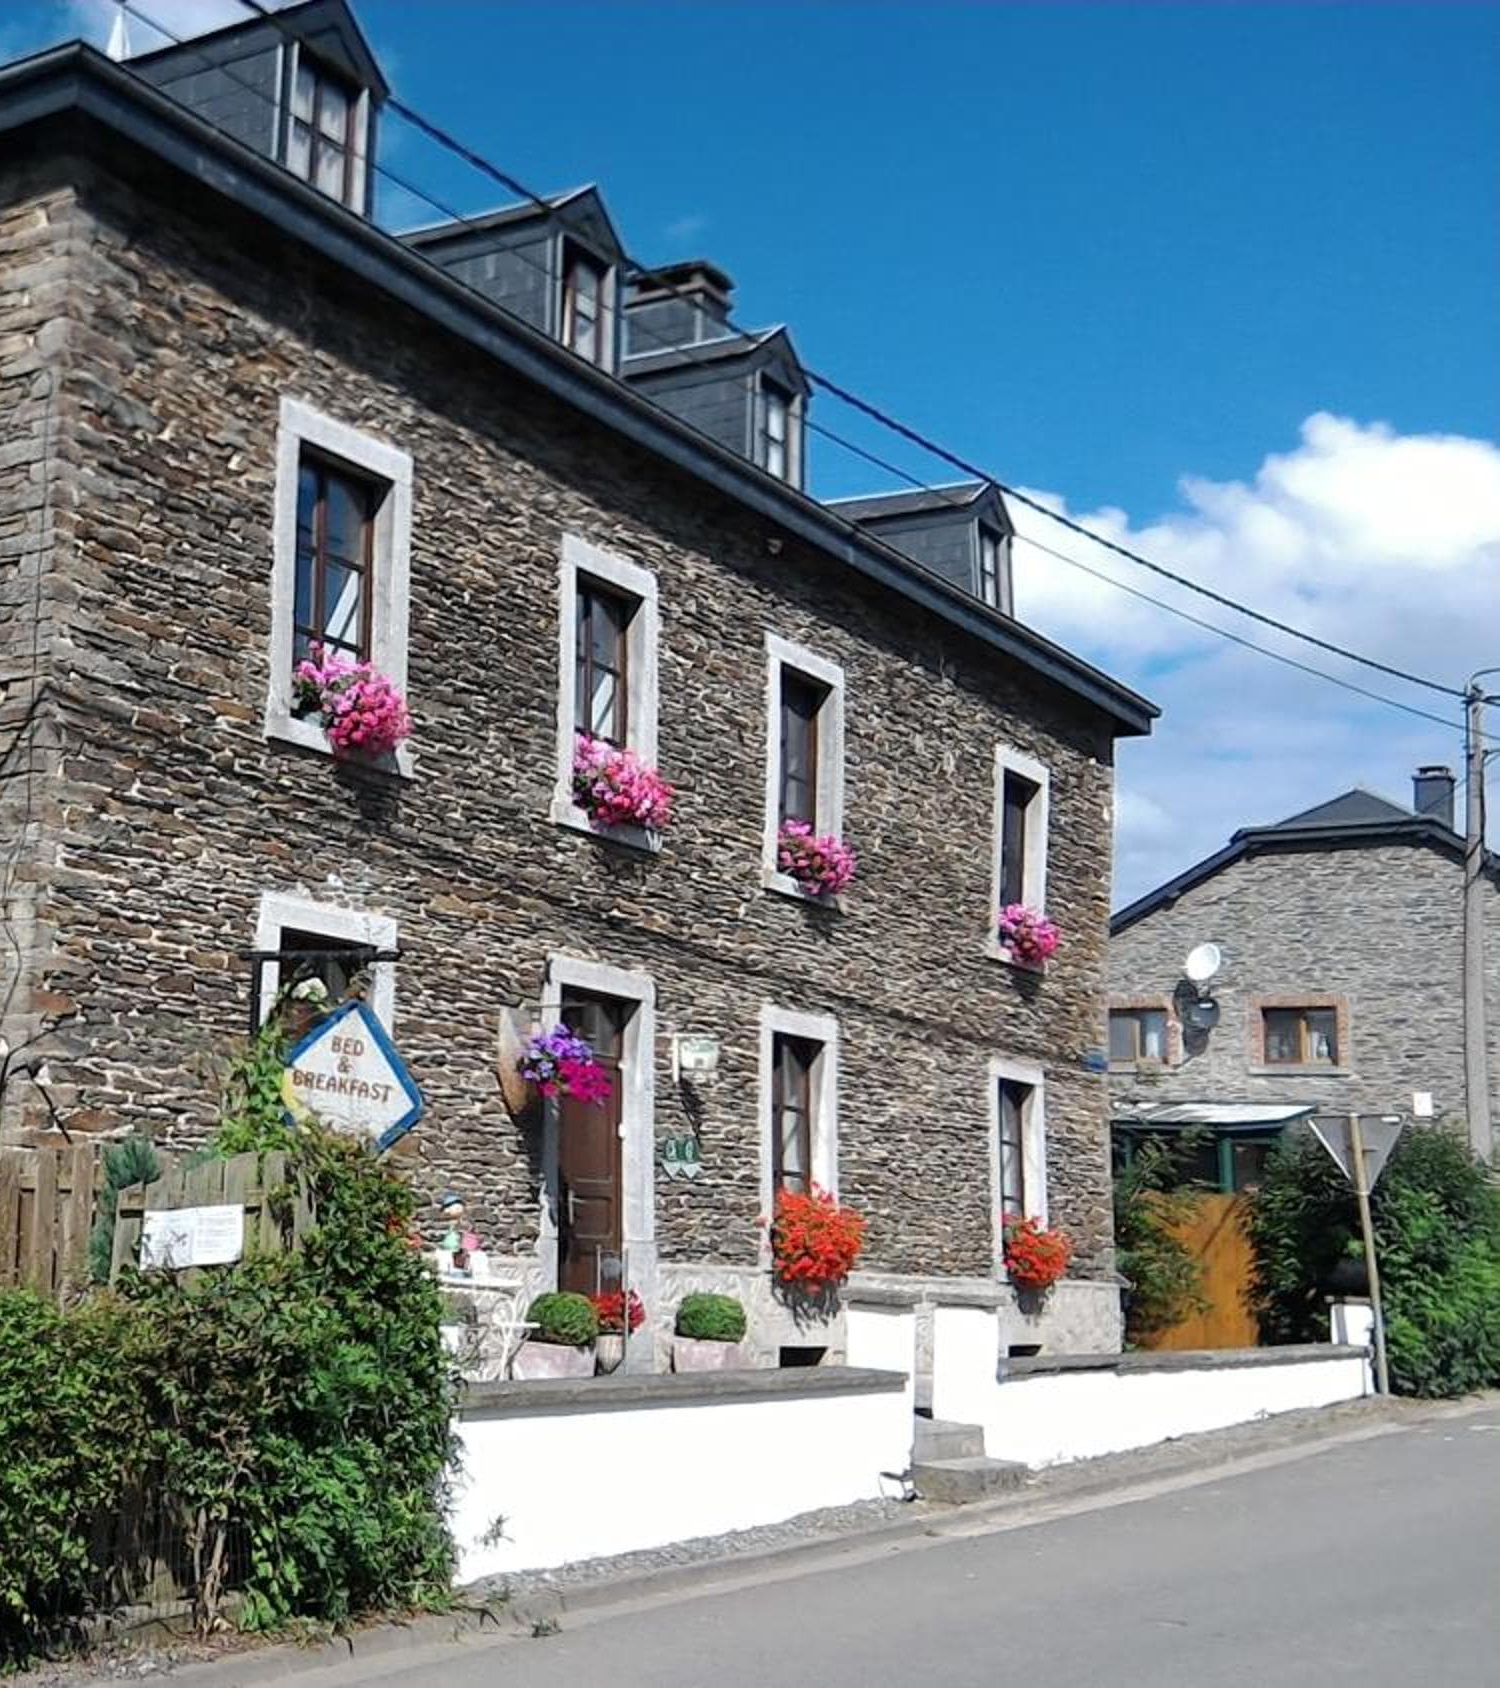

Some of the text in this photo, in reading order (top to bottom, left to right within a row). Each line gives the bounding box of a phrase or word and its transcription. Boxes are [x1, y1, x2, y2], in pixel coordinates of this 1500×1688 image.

[331, 1035, 365, 1057] BED
[337, 1056, 352, 1073] &
[292, 1069, 394, 1104] BREAKFAST
